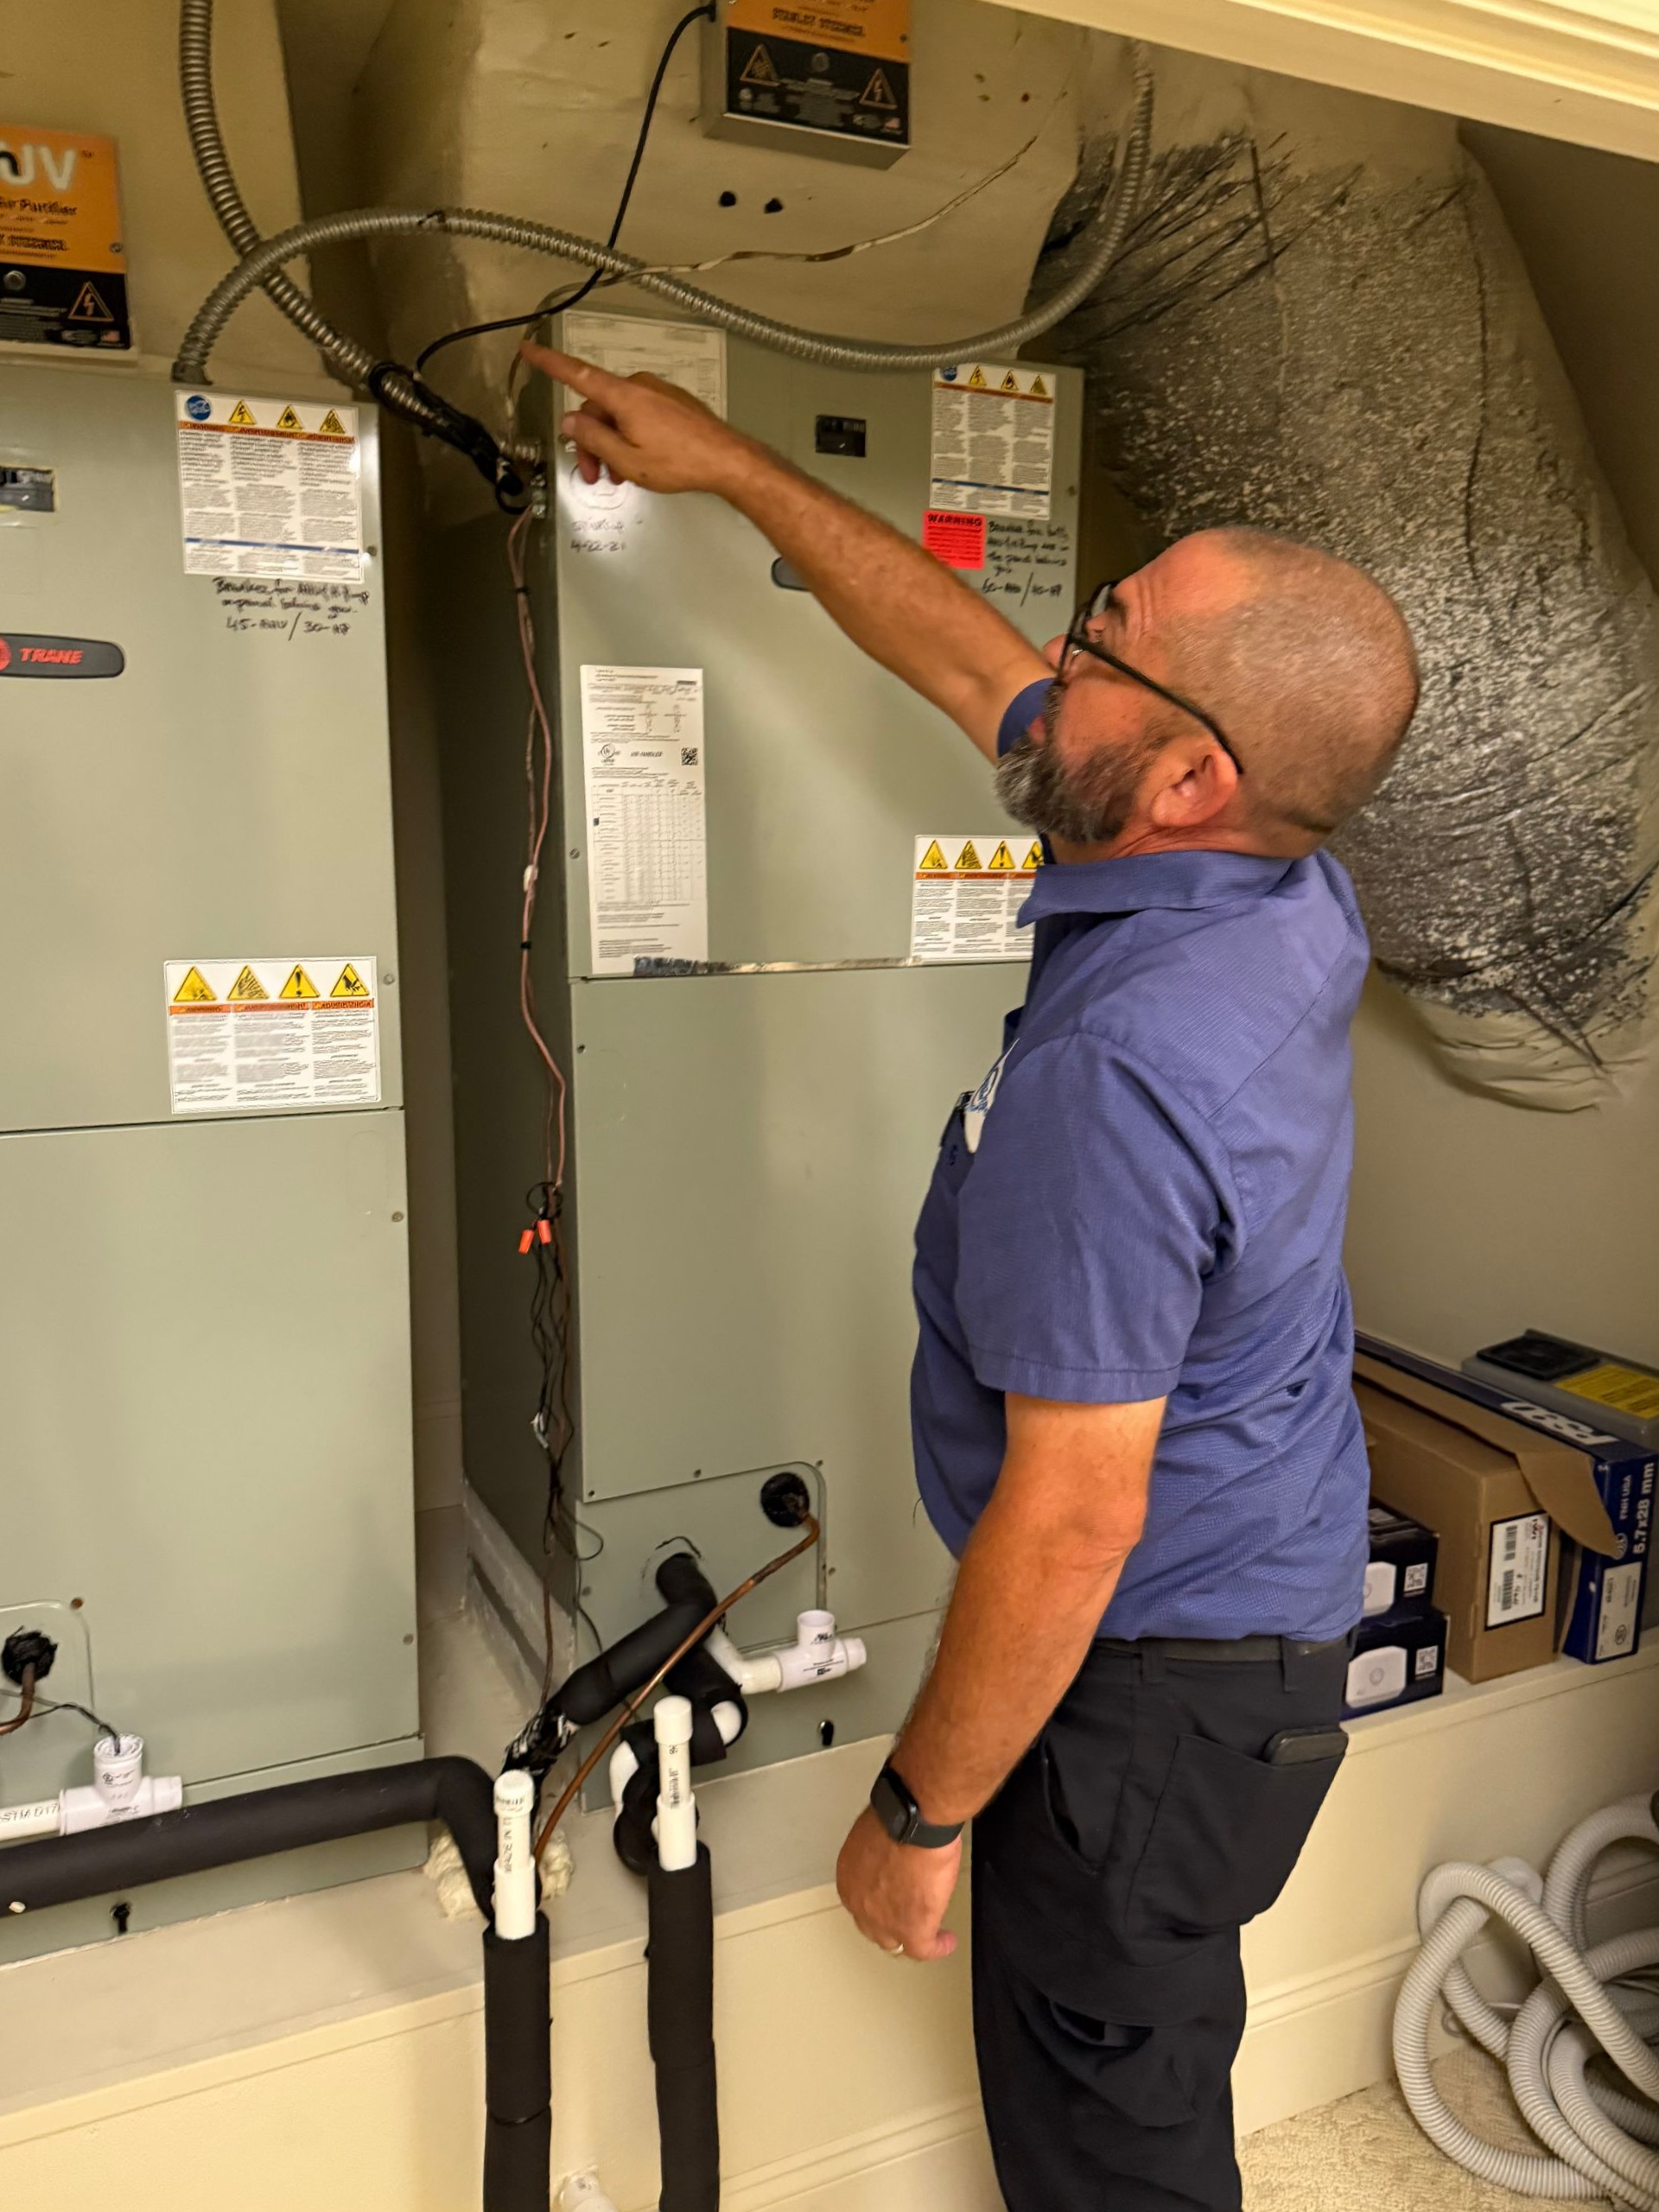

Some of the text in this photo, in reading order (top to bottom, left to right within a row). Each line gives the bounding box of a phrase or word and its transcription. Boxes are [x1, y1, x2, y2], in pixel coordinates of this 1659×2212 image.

[927, 514, 982, 526] WARNING
[19, 647, 84, 664] TRANE
[1622, 1474, 1632, 1497] USA
[1632, 1462, 1655, 1554] 5.7x28 mm
